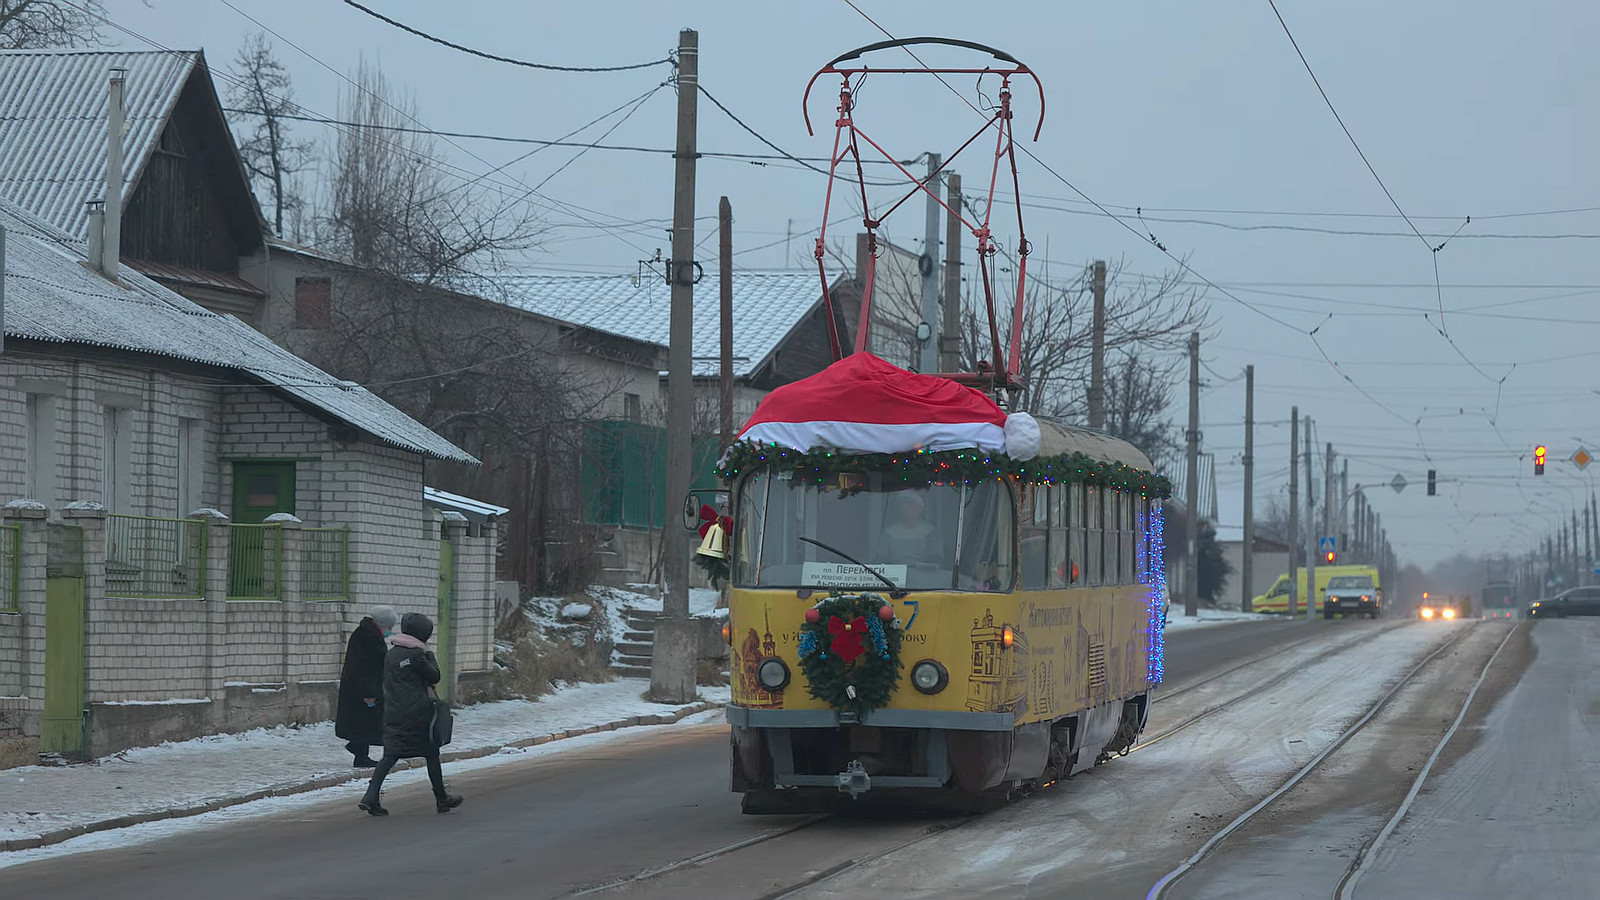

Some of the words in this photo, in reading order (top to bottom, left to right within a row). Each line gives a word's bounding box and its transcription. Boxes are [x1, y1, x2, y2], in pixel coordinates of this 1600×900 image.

[836, 565, 885, 575] ПЕРЕМОГИ
[903, 601, 918, 630] 7
[782, 633, 789, 644] у
[1032, 660, 1055, 715] 120
